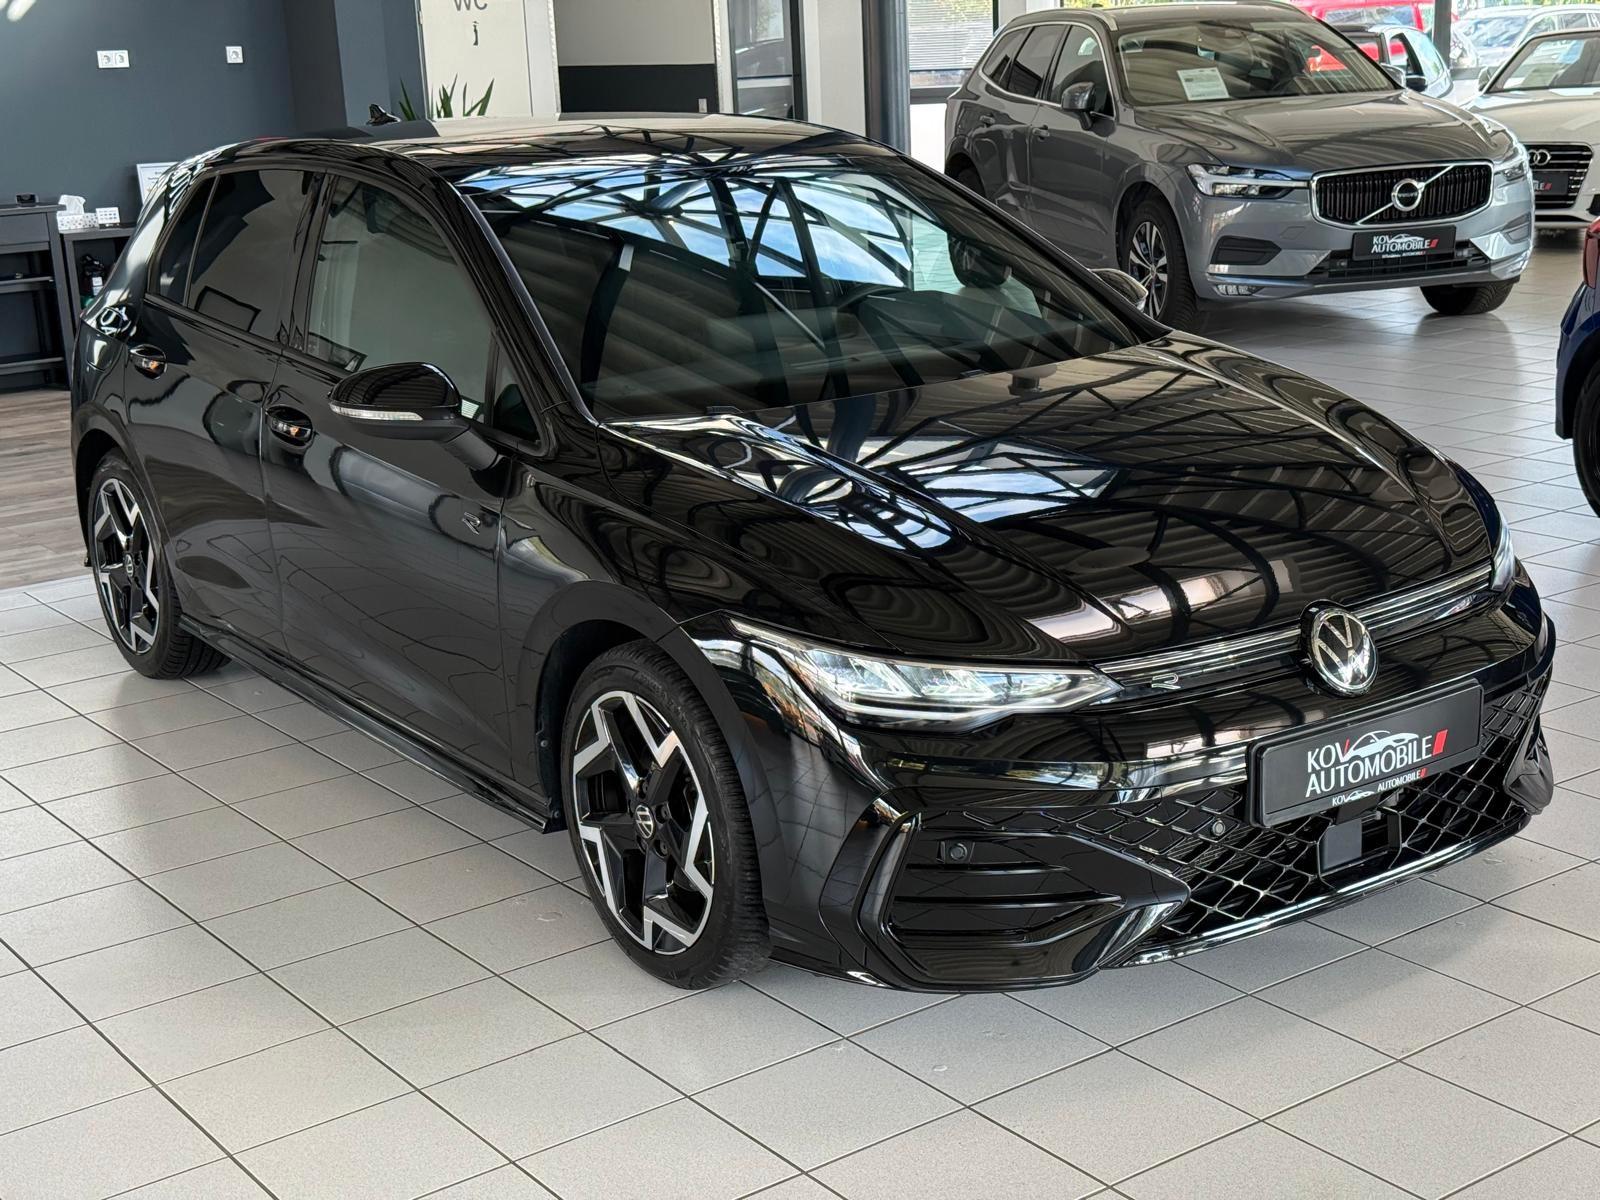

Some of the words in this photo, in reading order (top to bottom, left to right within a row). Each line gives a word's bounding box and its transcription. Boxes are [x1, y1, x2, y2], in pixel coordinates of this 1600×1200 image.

[1371, 239, 1430, 253] AUTOMOBILE
[1372, 234, 1392, 245] KOV
[1305, 735, 1432, 797] AUTOMOBILE
[1307, 739, 1350, 772] KOV
[1332, 793, 1349, 806] KOV
[1377, 769, 1421, 792] AUTOMOBILE
